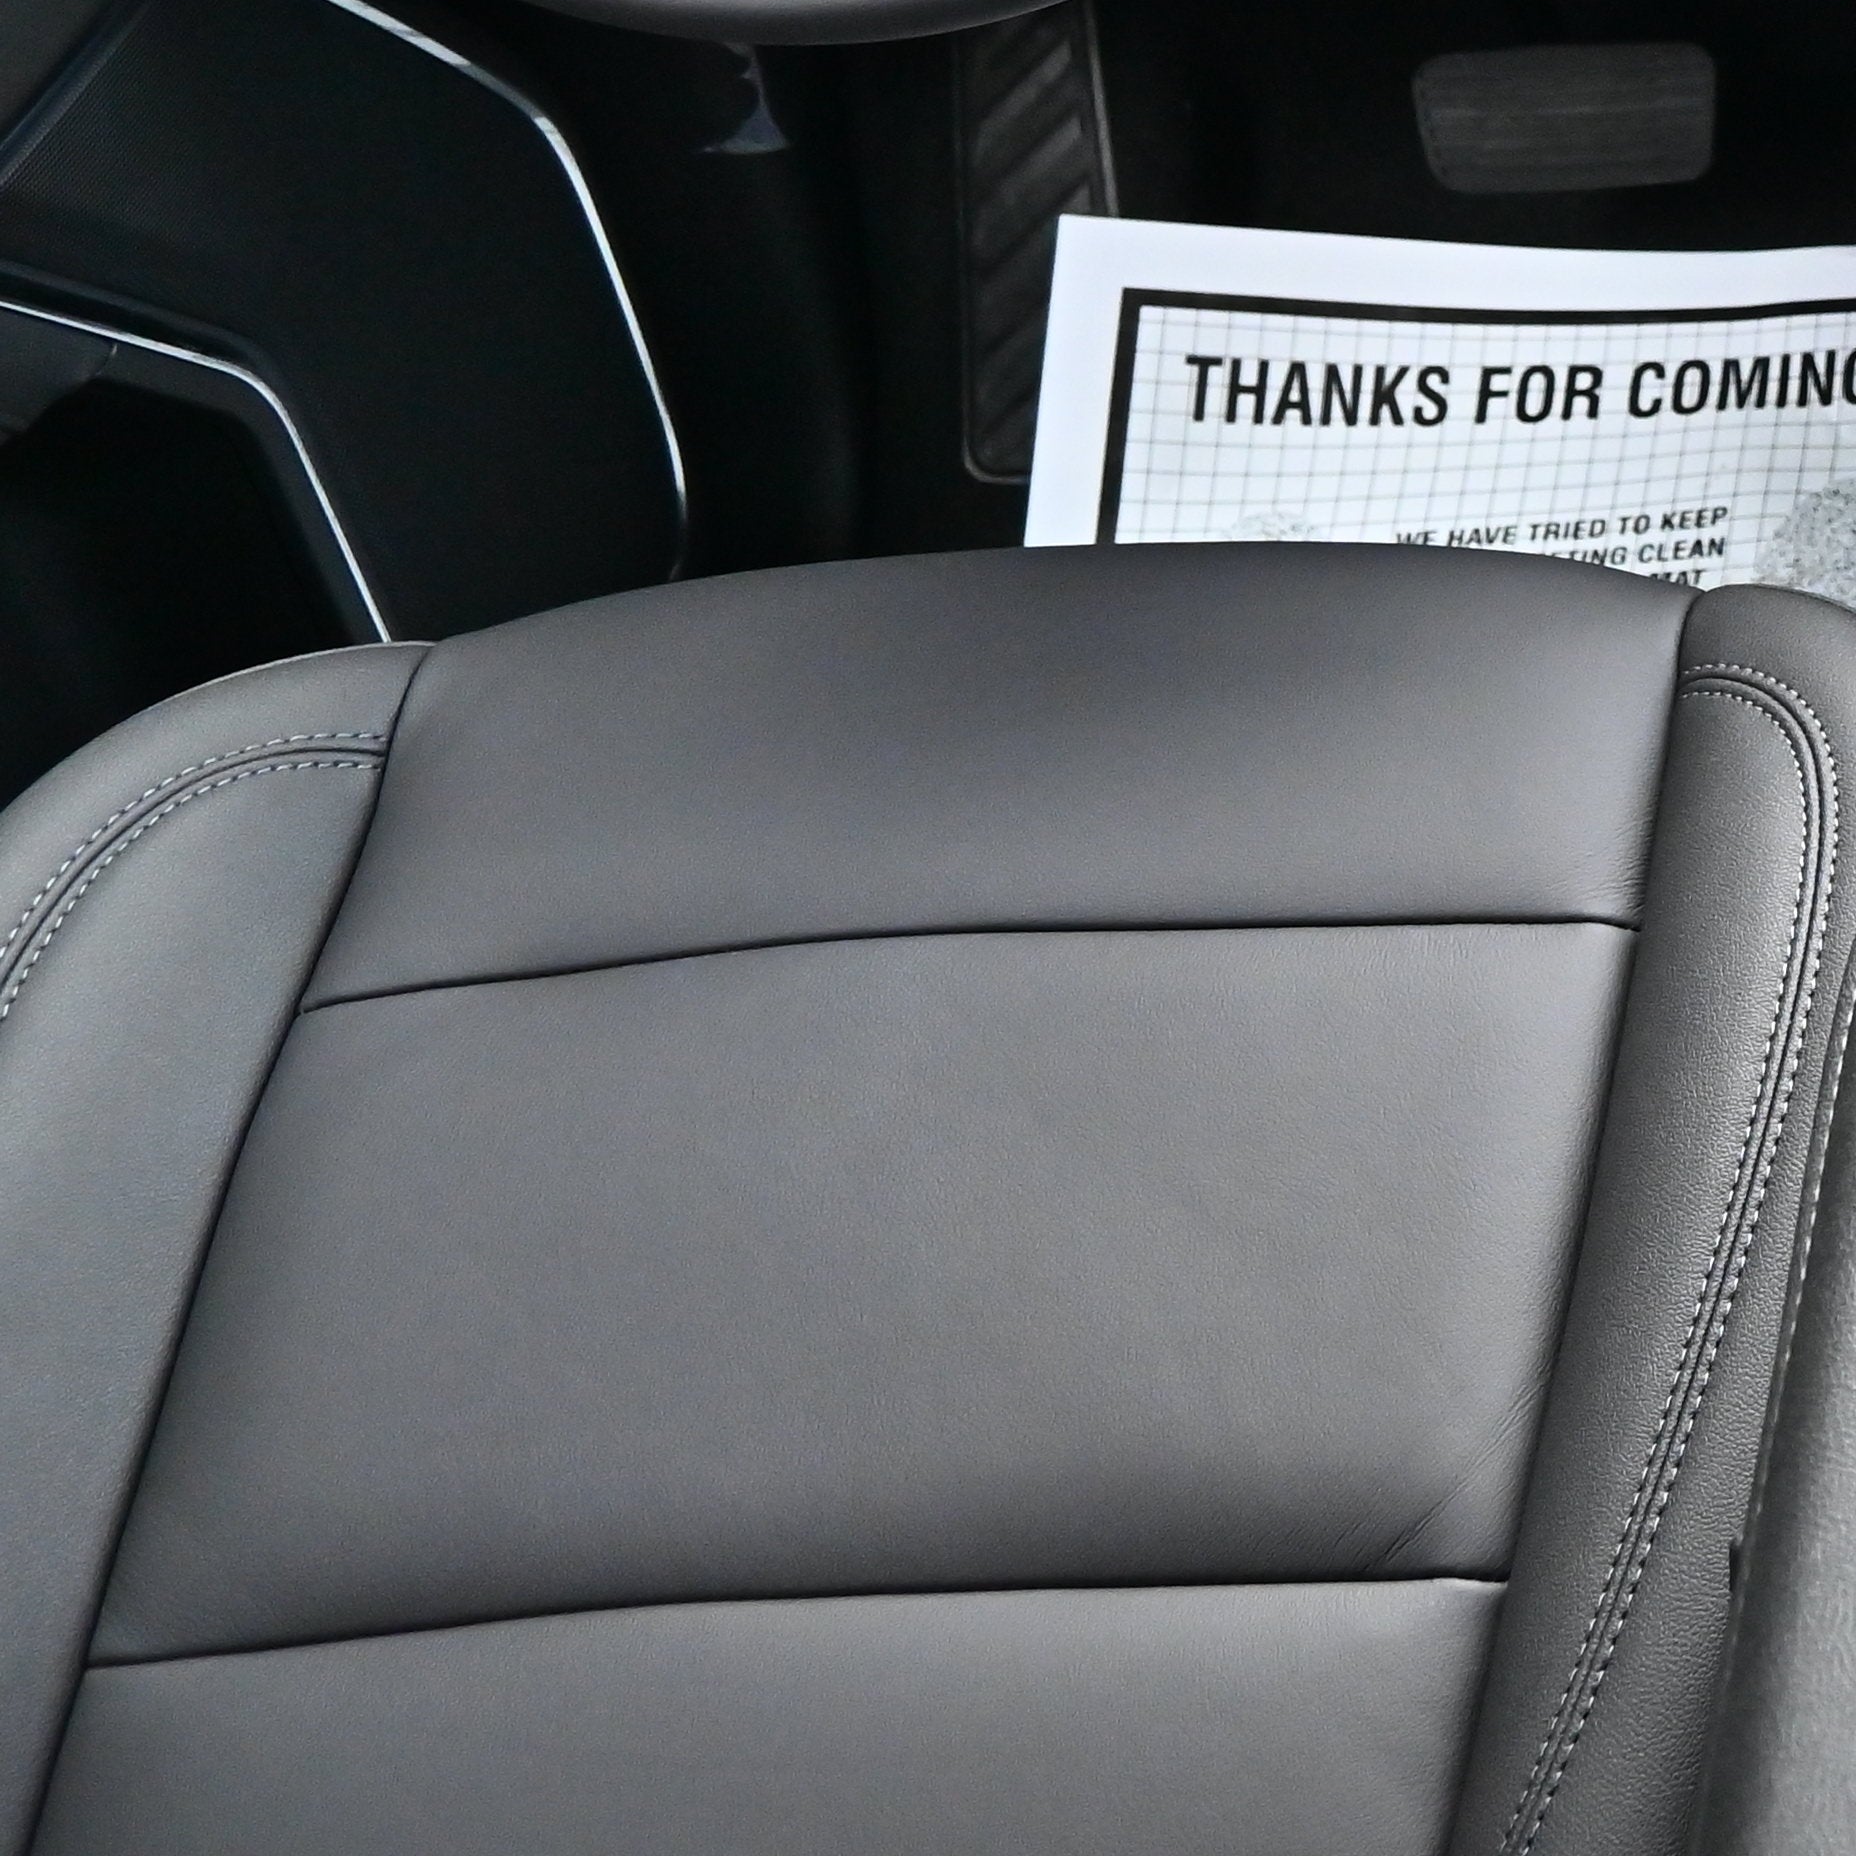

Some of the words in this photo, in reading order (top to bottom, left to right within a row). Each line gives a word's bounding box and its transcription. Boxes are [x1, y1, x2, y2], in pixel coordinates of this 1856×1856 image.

[1186, 353, 1450, 428] THANKS
[1474, 365, 1602, 425] FOR
[1449, 524, 1517, 548] HAVE
[1529, 519, 1607, 542] TRIED
[1618, 514, 1651, 536] TO
[1660, 506, 1729, 532] KEEP
[1638, 537, 1726, 564] CLEAN
